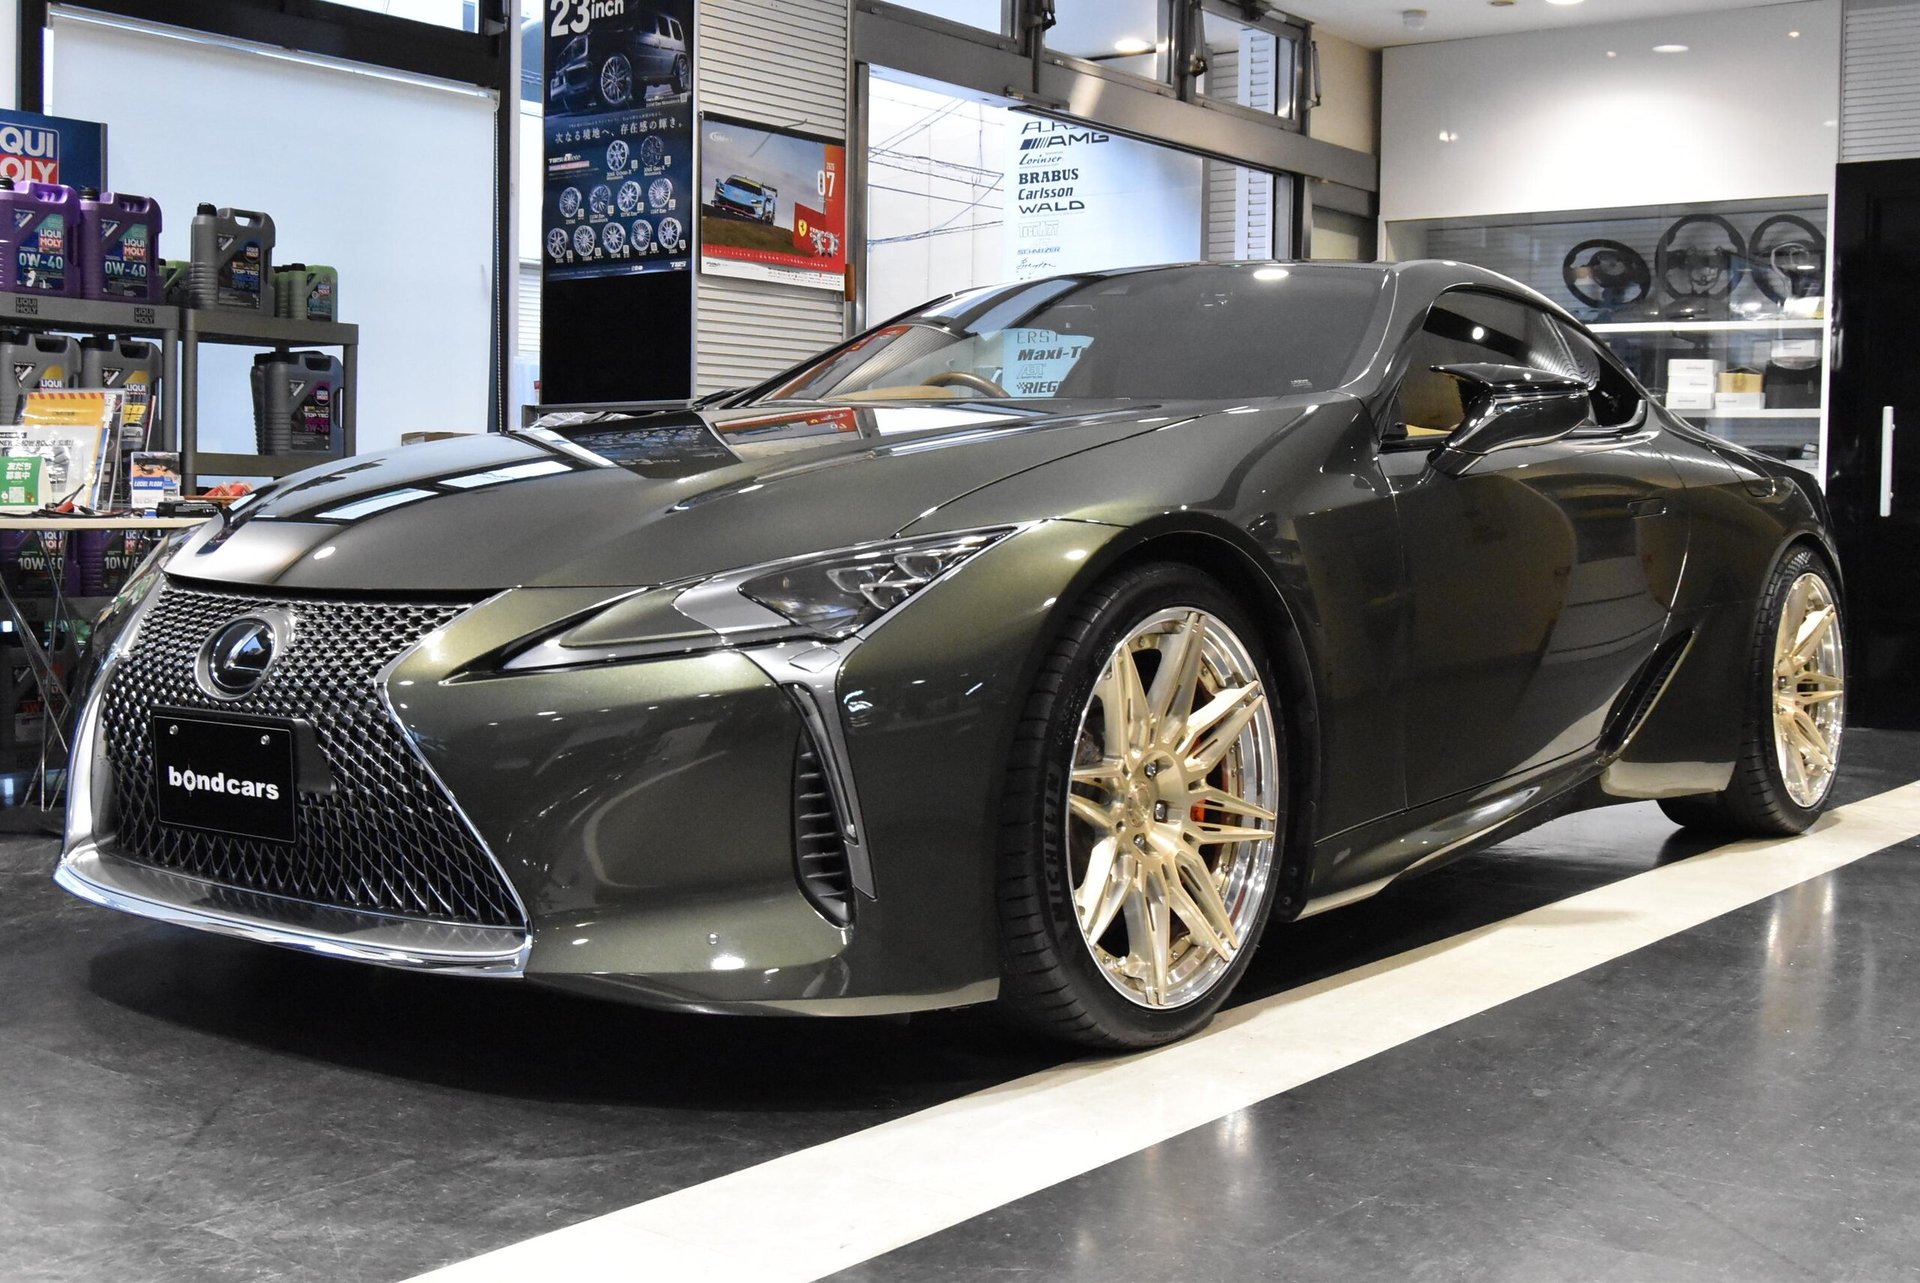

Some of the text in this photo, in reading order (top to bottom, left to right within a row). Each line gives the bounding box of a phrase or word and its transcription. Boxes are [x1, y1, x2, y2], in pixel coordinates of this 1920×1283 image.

[550, 0, 624, 37] 23 inch
[0, 126, 54, 158] QUI
[1047, 132, 1110, 148] AMG
[0, 156, 56, 184] OLY
[1018, 168, 1079, 185] BRABUS
[817, 170, 835, 198] 07
[1018, 186, 1074, 201] Carlsson
[1018, 200, 1085, 214] WALD
[40, 229, 62, 239] LIQUI
[39, 238, 63, 248] MOLY
[124, 238, 145, 248] LIQUI
[124, 246, 146, 256] MOLY
[19, 252, 64, 270] 0W-40
[104, 261, 147, 278] 0W-40
[41, 380, 62, 388] LIQUI
[126, 384, 146, 392] LIQUI
[1022, 380, 1062, 393] RIEG
[42, 531, 62, 540] IQI
[104, 556, 140, 569] 10W
[168, 765, 280, 800] bondcars
